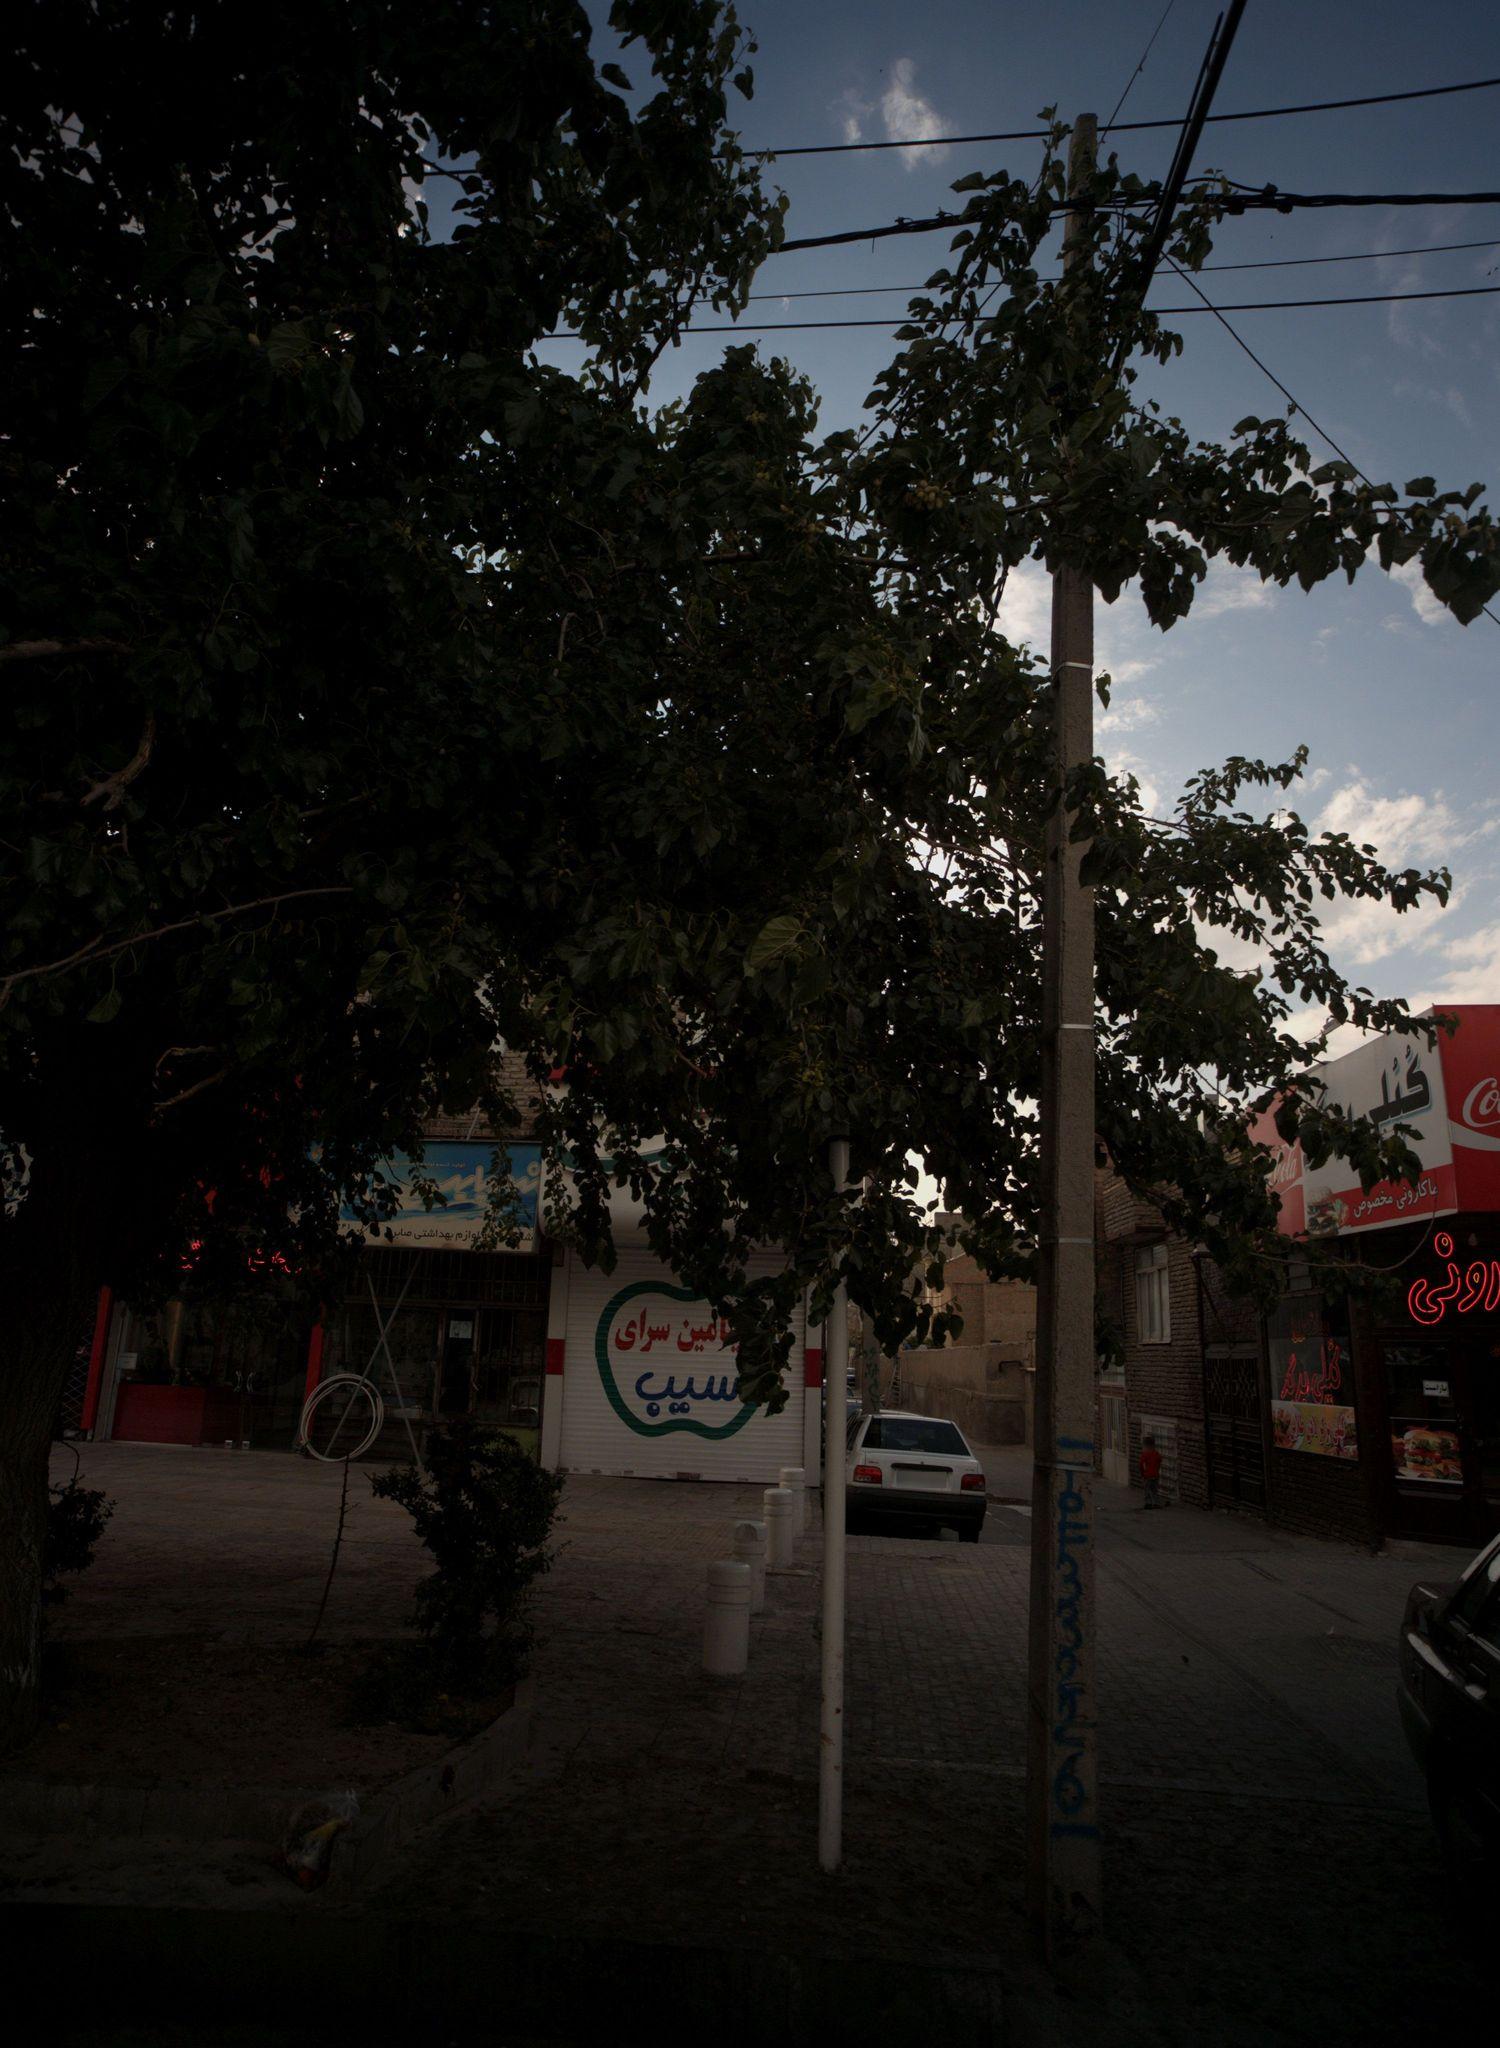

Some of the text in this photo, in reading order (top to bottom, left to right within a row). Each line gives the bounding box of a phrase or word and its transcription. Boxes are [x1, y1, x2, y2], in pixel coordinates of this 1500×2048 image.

[1462, 1076, 1500, 1128] Co
[1353, 1177, 1438, 1218] ماکارونی مخصوص
[414, 1228, 454, 1240] بهداشتی
[614, 1307, 671, 1352] سرای
[635, 1371, 741, 1418] سیب
